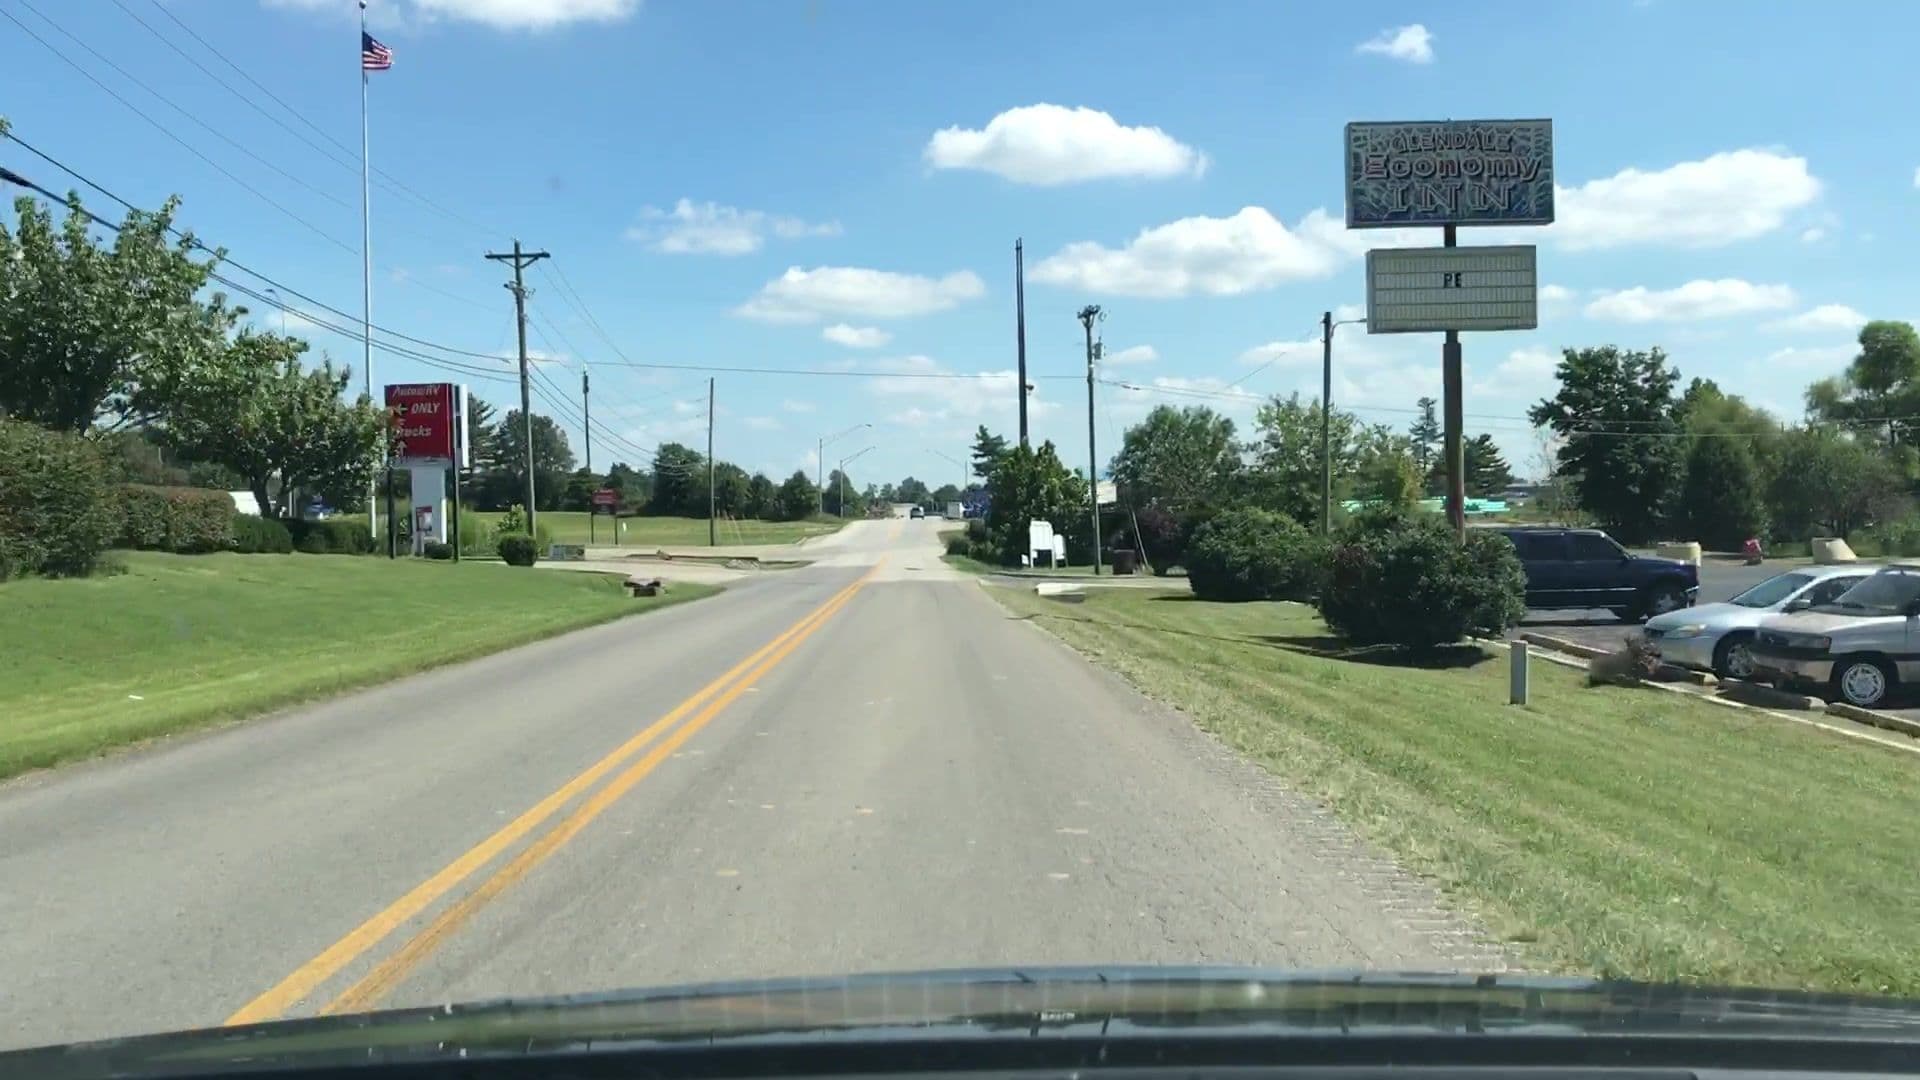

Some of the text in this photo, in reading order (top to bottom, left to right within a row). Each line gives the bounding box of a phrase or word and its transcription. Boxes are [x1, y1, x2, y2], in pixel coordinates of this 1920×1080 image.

[1392, 131, 1515, 152] GLENDALE
[1365, 154, 1542, 181] Economy
[1387, 183, 1516, 213] INN
[411, 402, 441, 415] ONLY
